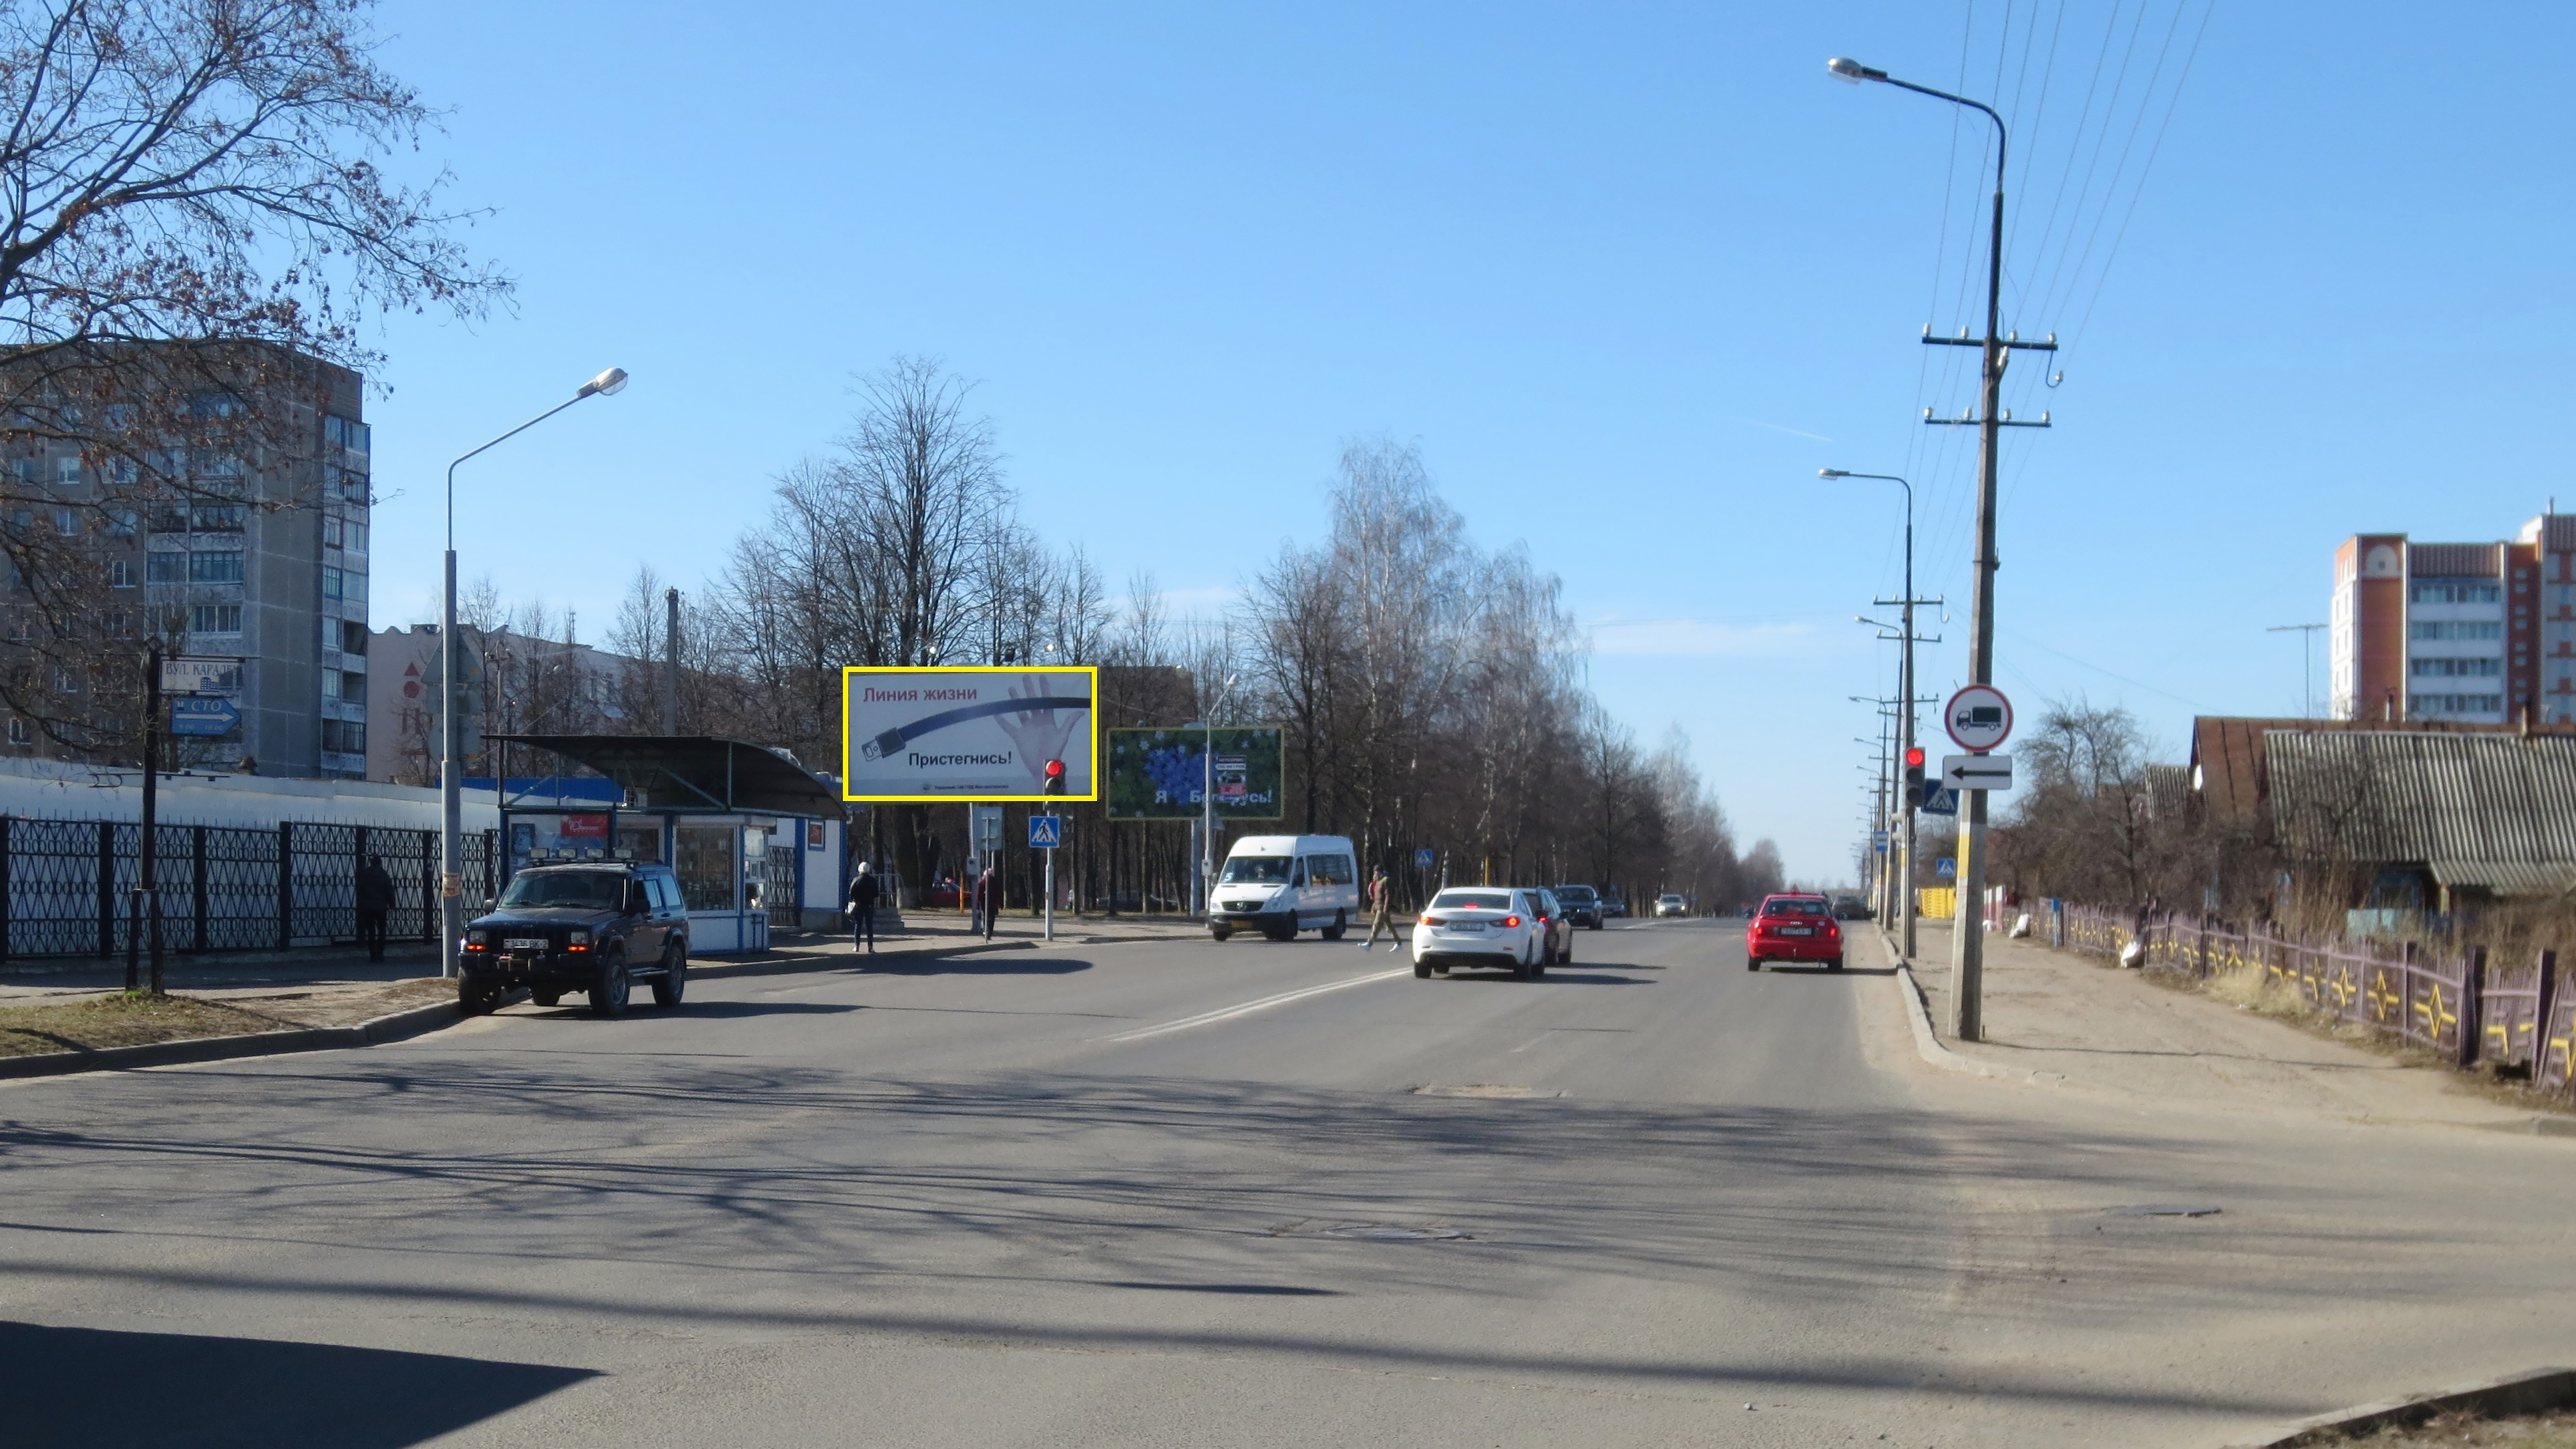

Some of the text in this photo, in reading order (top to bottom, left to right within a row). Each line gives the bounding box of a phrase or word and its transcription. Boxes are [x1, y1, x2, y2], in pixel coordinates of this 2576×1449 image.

[166, 663, 189, 676] ВУЛ.
[864, 687, 978, 703] Линия жизни
[191, 701, 222, 712] СТО
[909, 751, 1012, 768] Пристегнись!
[1155, 790, 1168, 804] Я
